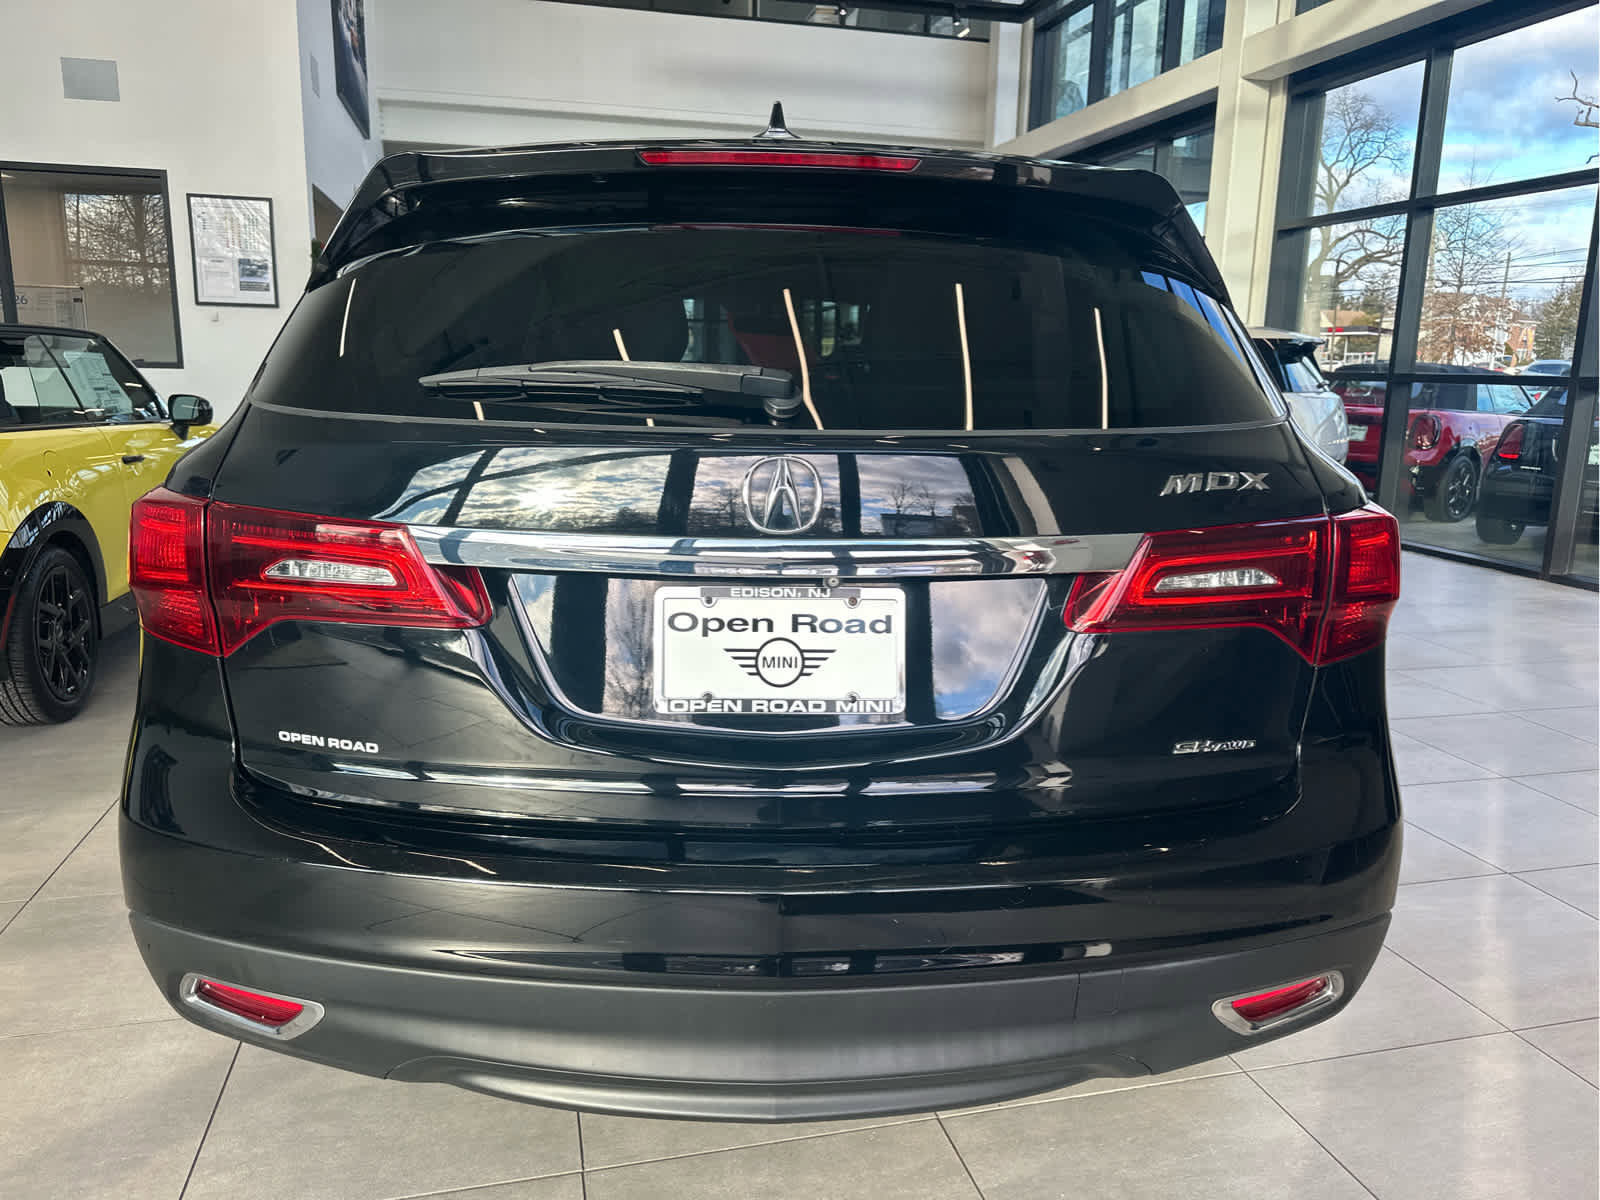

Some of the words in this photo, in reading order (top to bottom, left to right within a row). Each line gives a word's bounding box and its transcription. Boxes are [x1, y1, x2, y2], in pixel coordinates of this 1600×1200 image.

[1160, 471, 1270, 496] MDX
[808, 588, 832, 598] NJ
[667, 612, 774, 637] Open
[791, 613, 892, 634] Road
[762, 656, 798, 669] MINI
[669, 699, 742, 713] OPEN
[751, 699, 827, 713] ROAD
[835, 699, 891, 713] MINI
[278, 730, 325, 747] OPEN
[327, 738, 379, 754] ROAD
